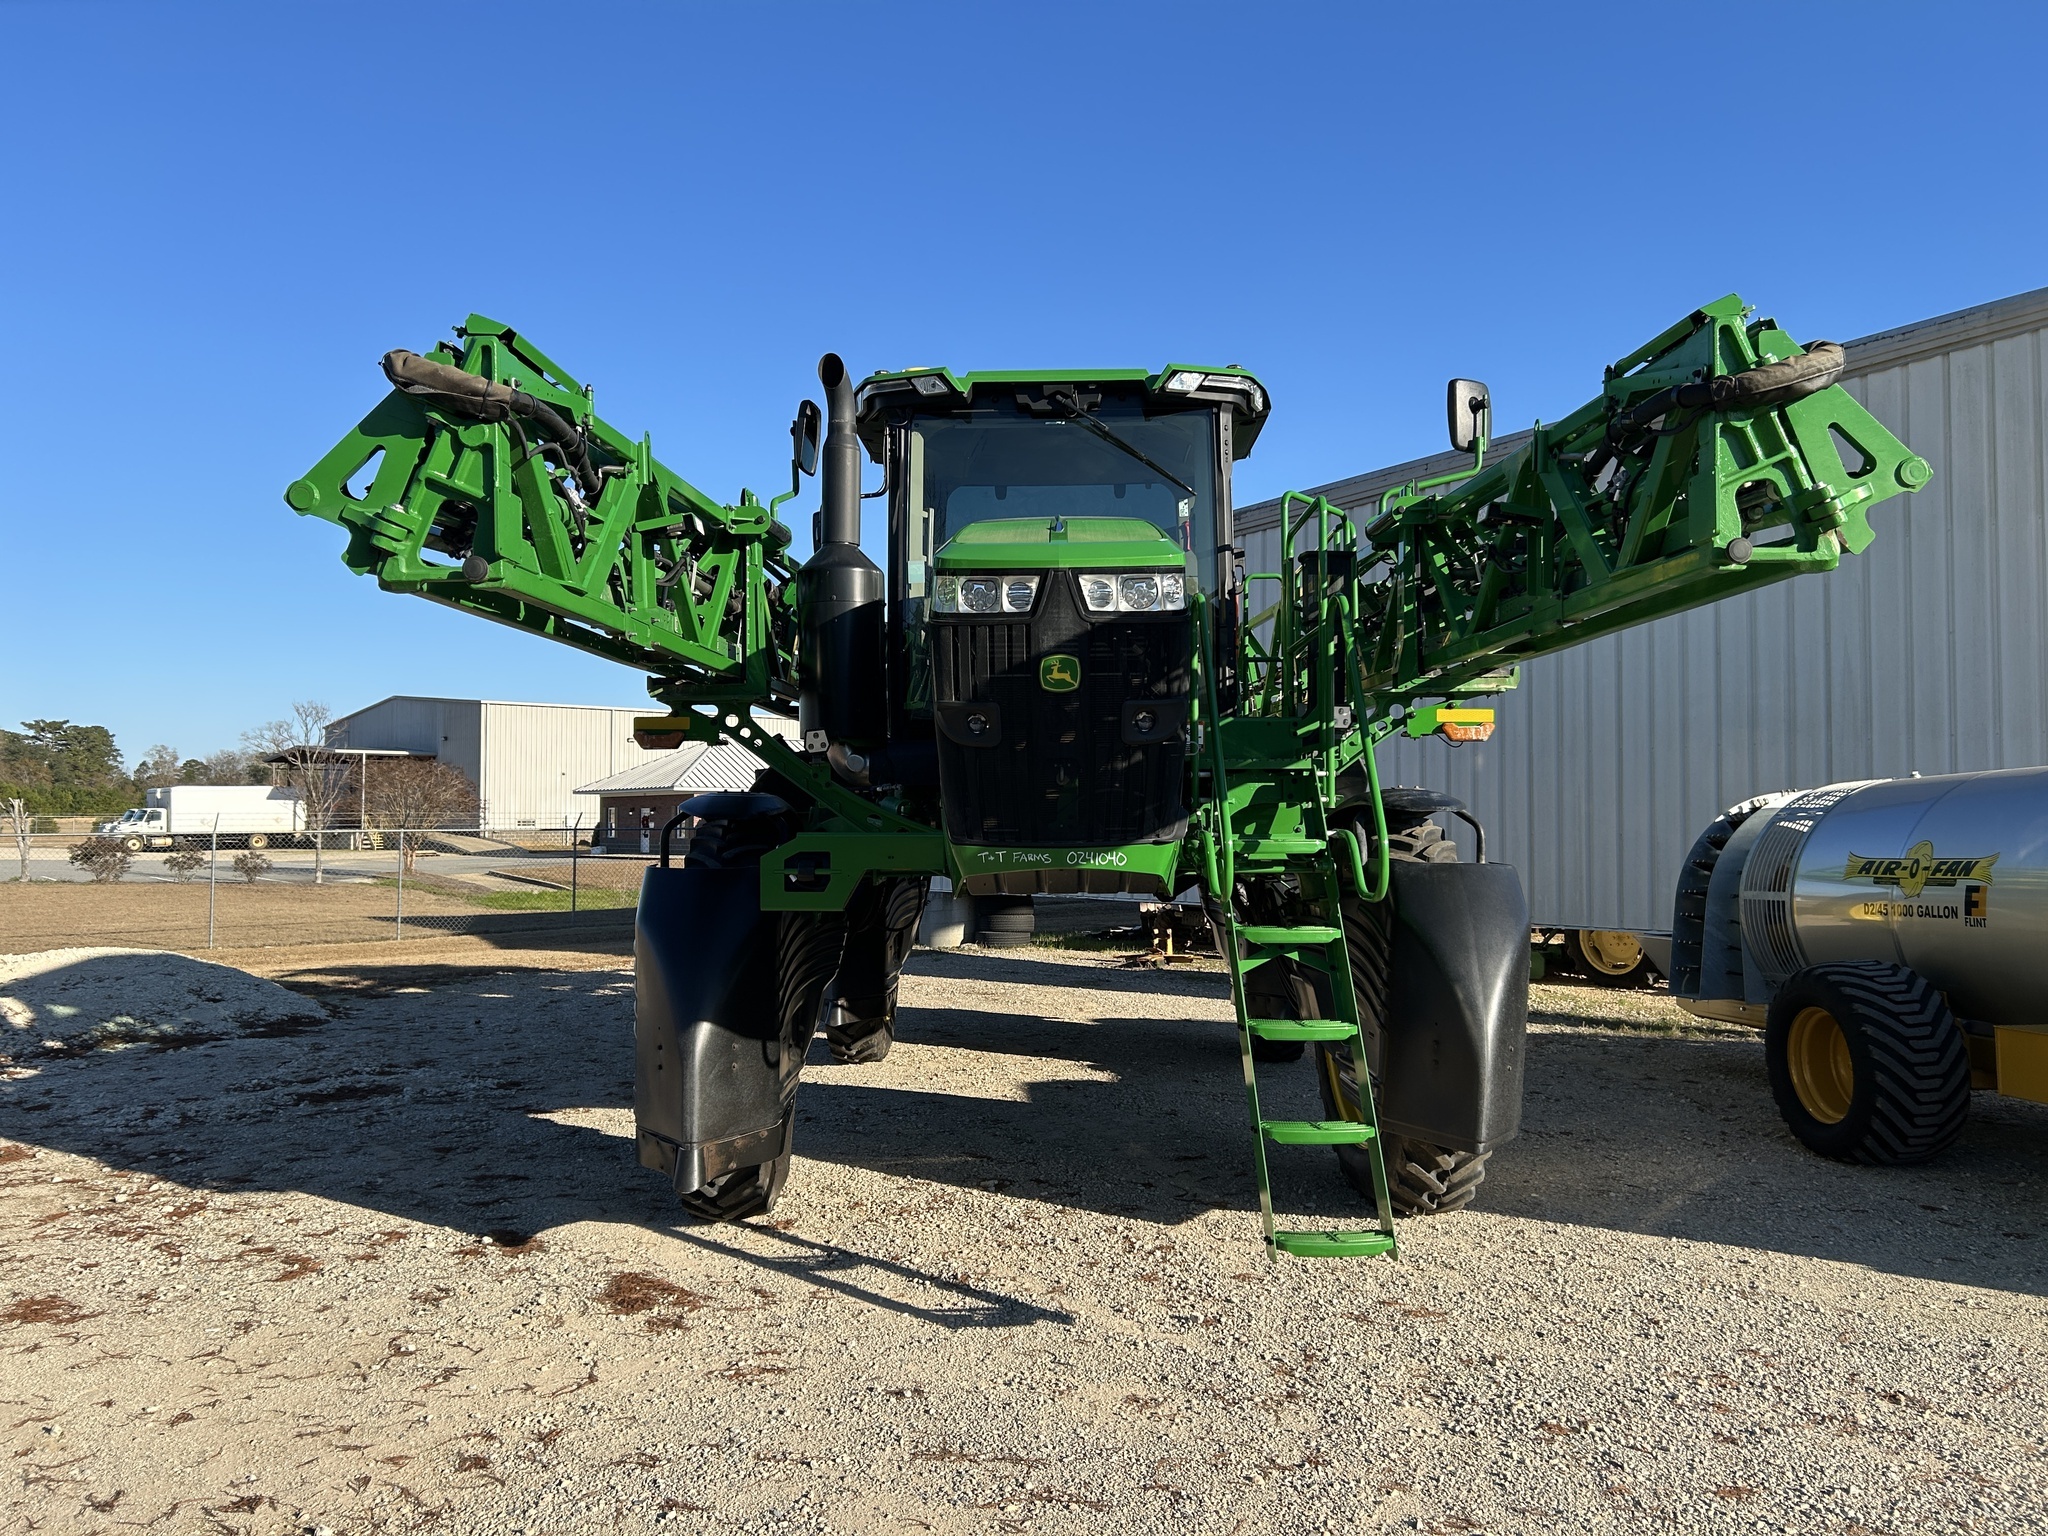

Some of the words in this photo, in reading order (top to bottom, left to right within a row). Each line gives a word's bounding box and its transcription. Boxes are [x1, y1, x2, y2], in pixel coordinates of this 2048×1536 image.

[1012, 851, 1051, 864] FARMS
[1066, 851, 1128, 866] 0241040
[1857, 858, 1980, 879] AIR-O-FAN
[1863, 903, 1889, 916] D2/45
[1891, 904, 1914, 918] 1000
[1916, 904, 1959, 919] GALLON
[1964, 917, 1987, 928] FLINT
